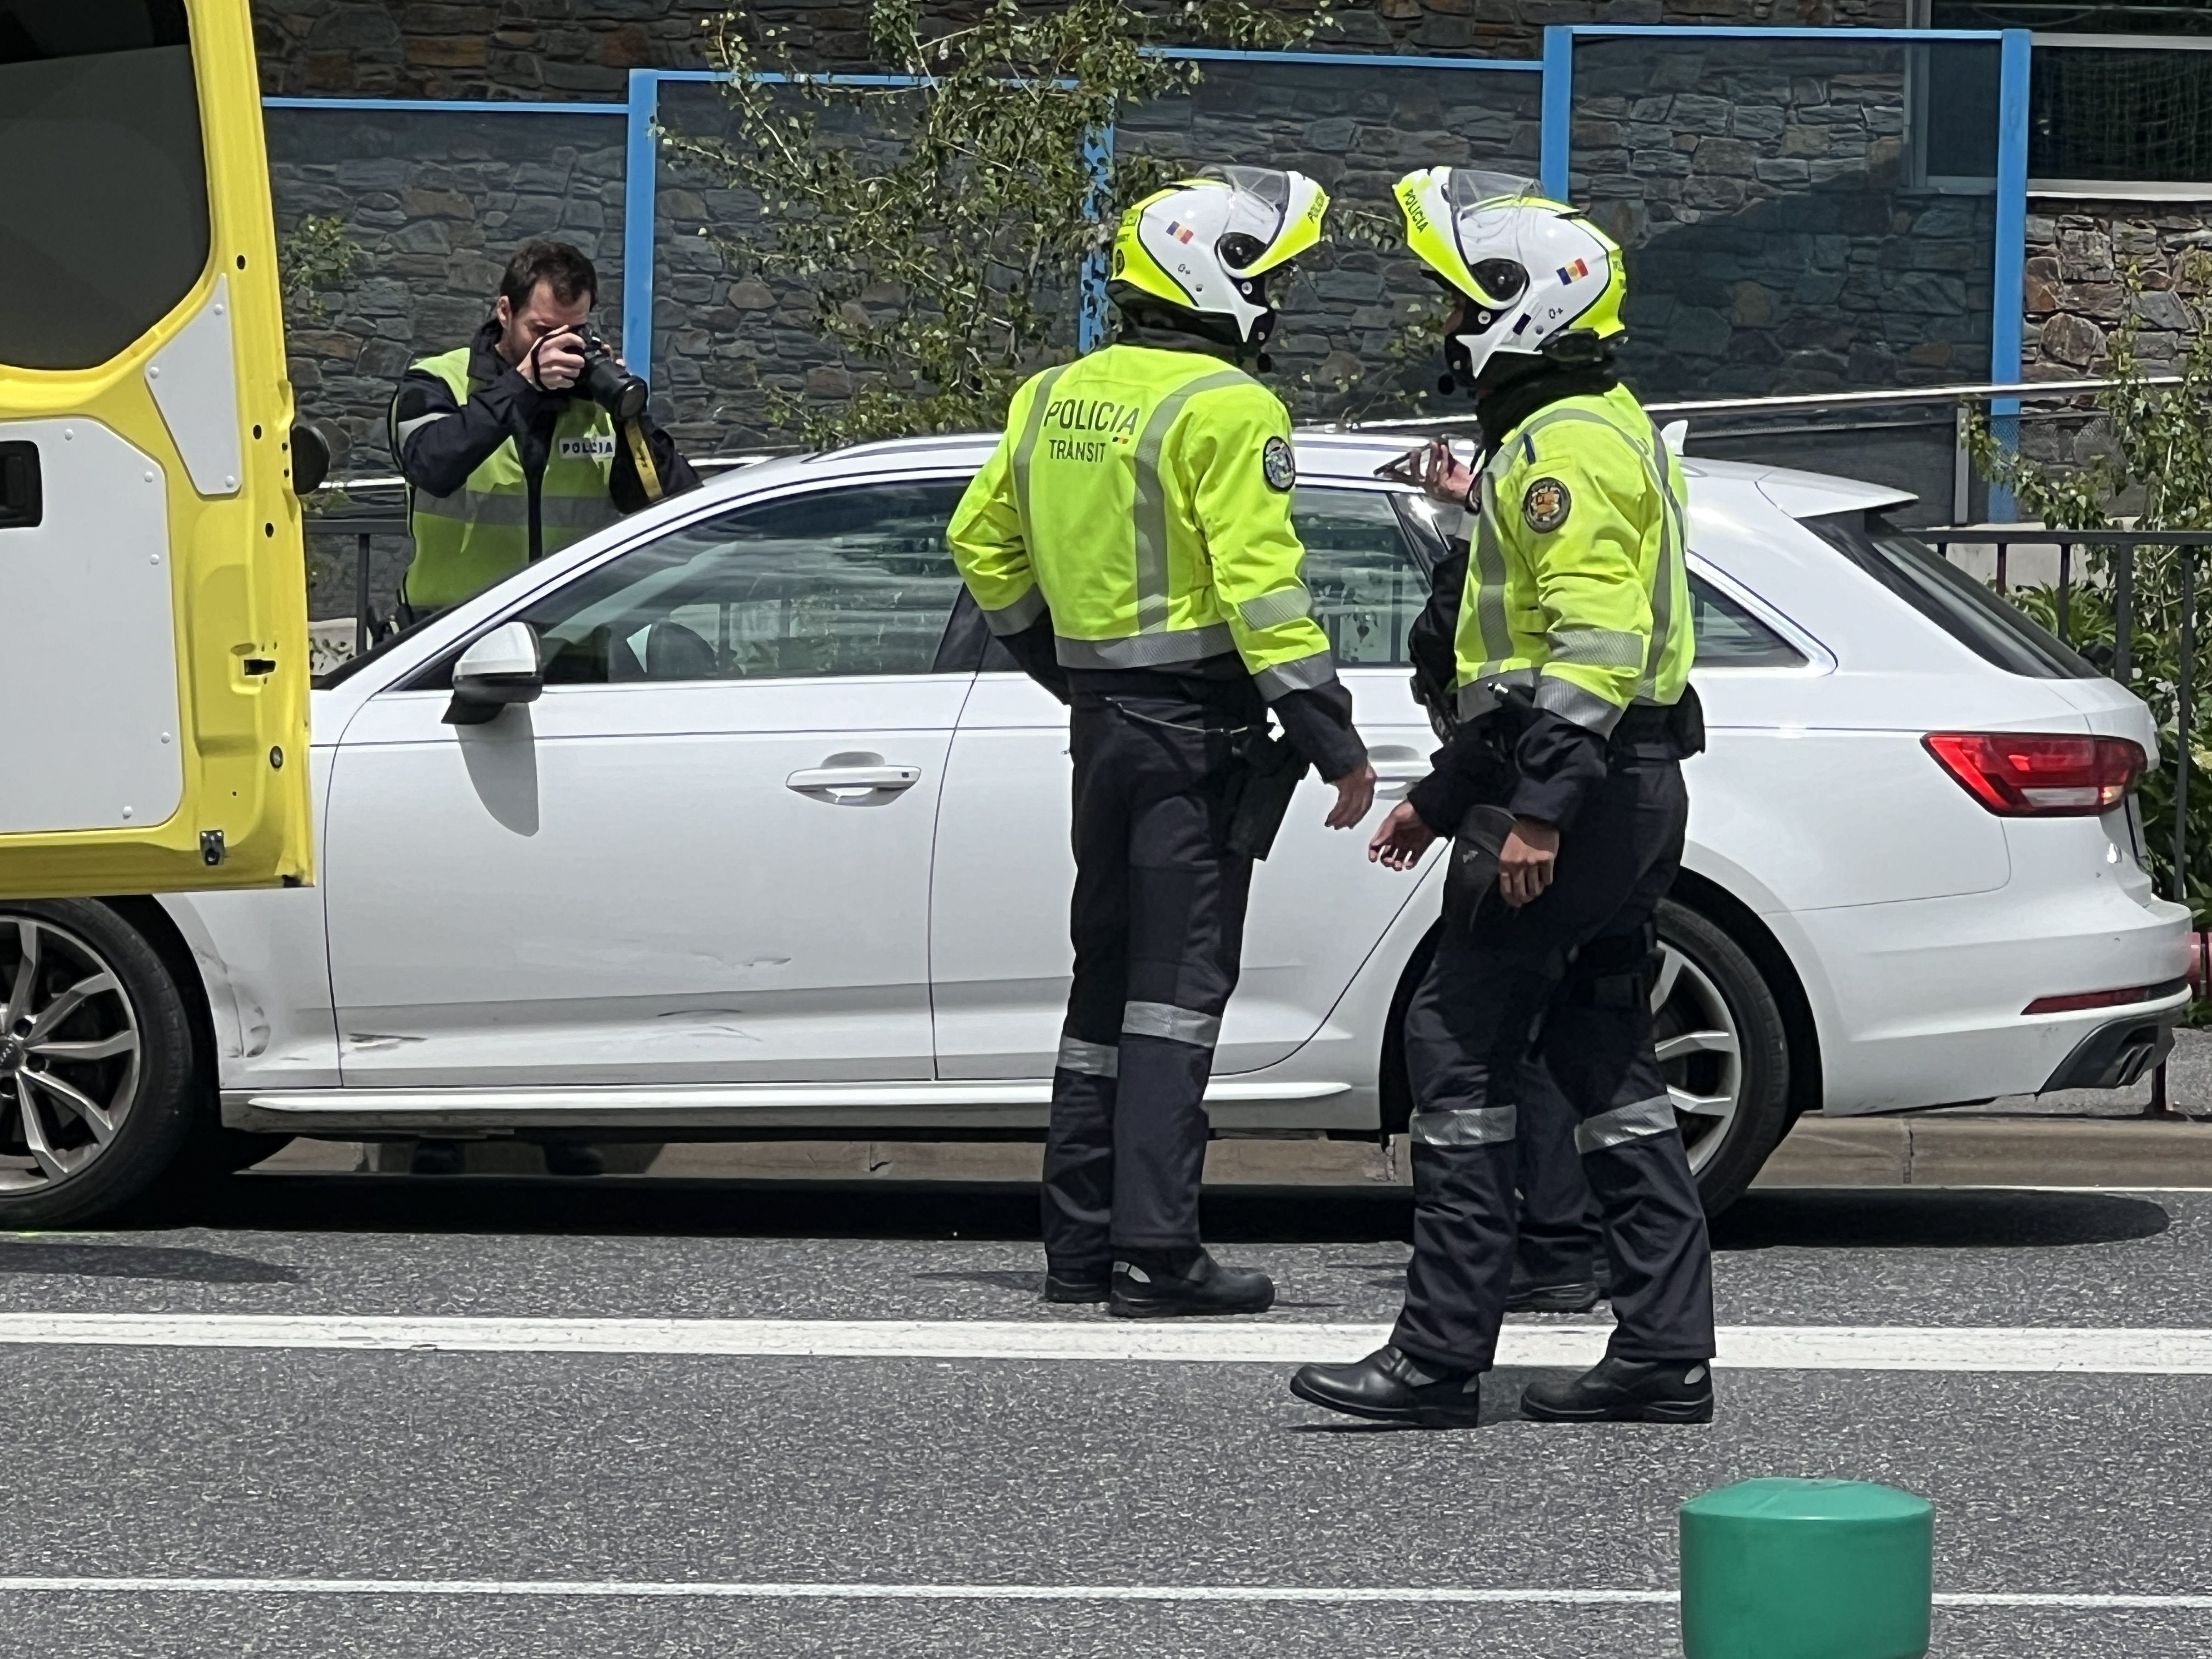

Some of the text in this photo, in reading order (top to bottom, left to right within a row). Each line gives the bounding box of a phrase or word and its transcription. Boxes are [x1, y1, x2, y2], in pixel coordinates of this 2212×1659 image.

[1403, 188, 1429, 234] POLICIA
[1043, 399, 1139, 435] POLICIA
[562, 442, 613, 454] POLICIA
[1049, 434, 1106, 462] TRÀNSIT
